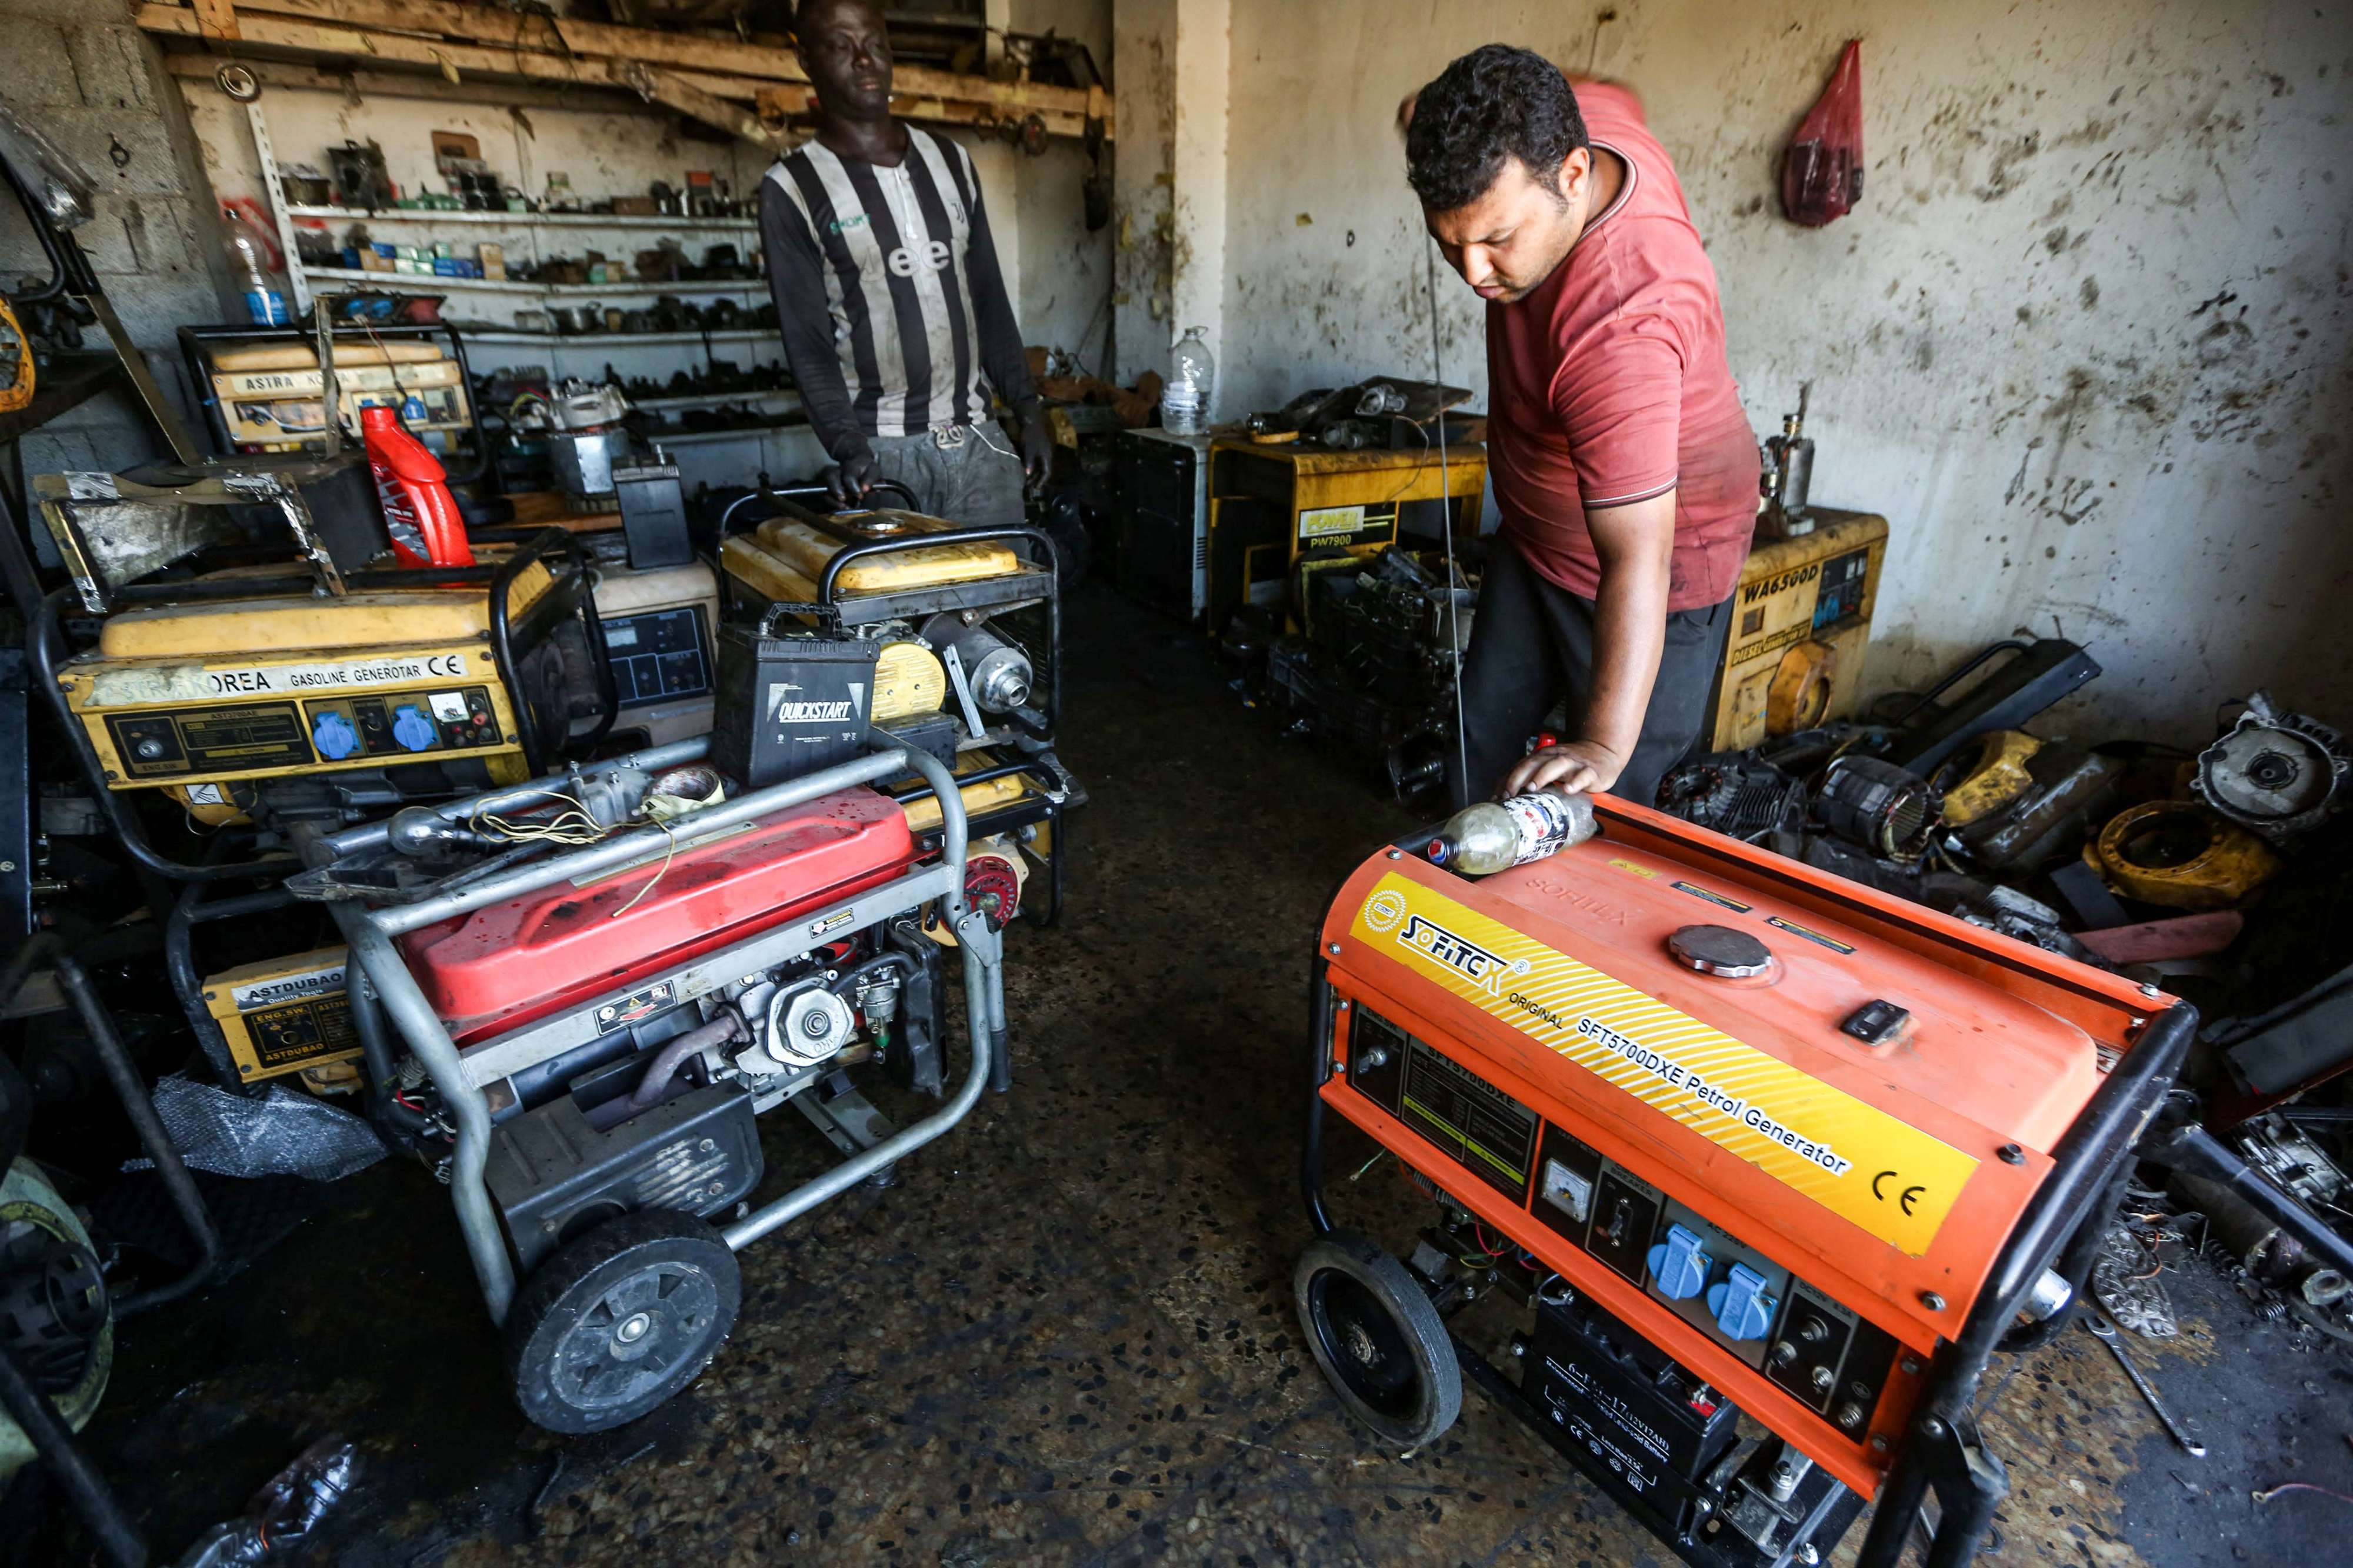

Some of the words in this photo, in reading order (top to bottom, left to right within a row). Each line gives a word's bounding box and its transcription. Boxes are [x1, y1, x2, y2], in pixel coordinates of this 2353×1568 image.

[245, 375, 294, 391] ASTRA
[1307, 511, 1358, 532] POWER
[1311, 535, 1352, 548] PW7900
[291, 670, 348, 687] GASOLINE
[354, 665, 422, 682] GENEROTAR
[778, 701, 852, 720] QUICKSTART
[249, 973, 342, 999] ASTDUBAO
[268, 993, 299, 1004] Quality
[266, 1042, 324, 1061] ASTDUBAO
[1509, 992, 1563, 1030] ORIGINAL
[1577, 1017, 1684, 1085] SFT5700DXE
[1685, 1076, 1742, 1116] Petrol
[1745, 1109, 1847, 1174] Generator
[1872, 1170, 1927, 1217] CE
